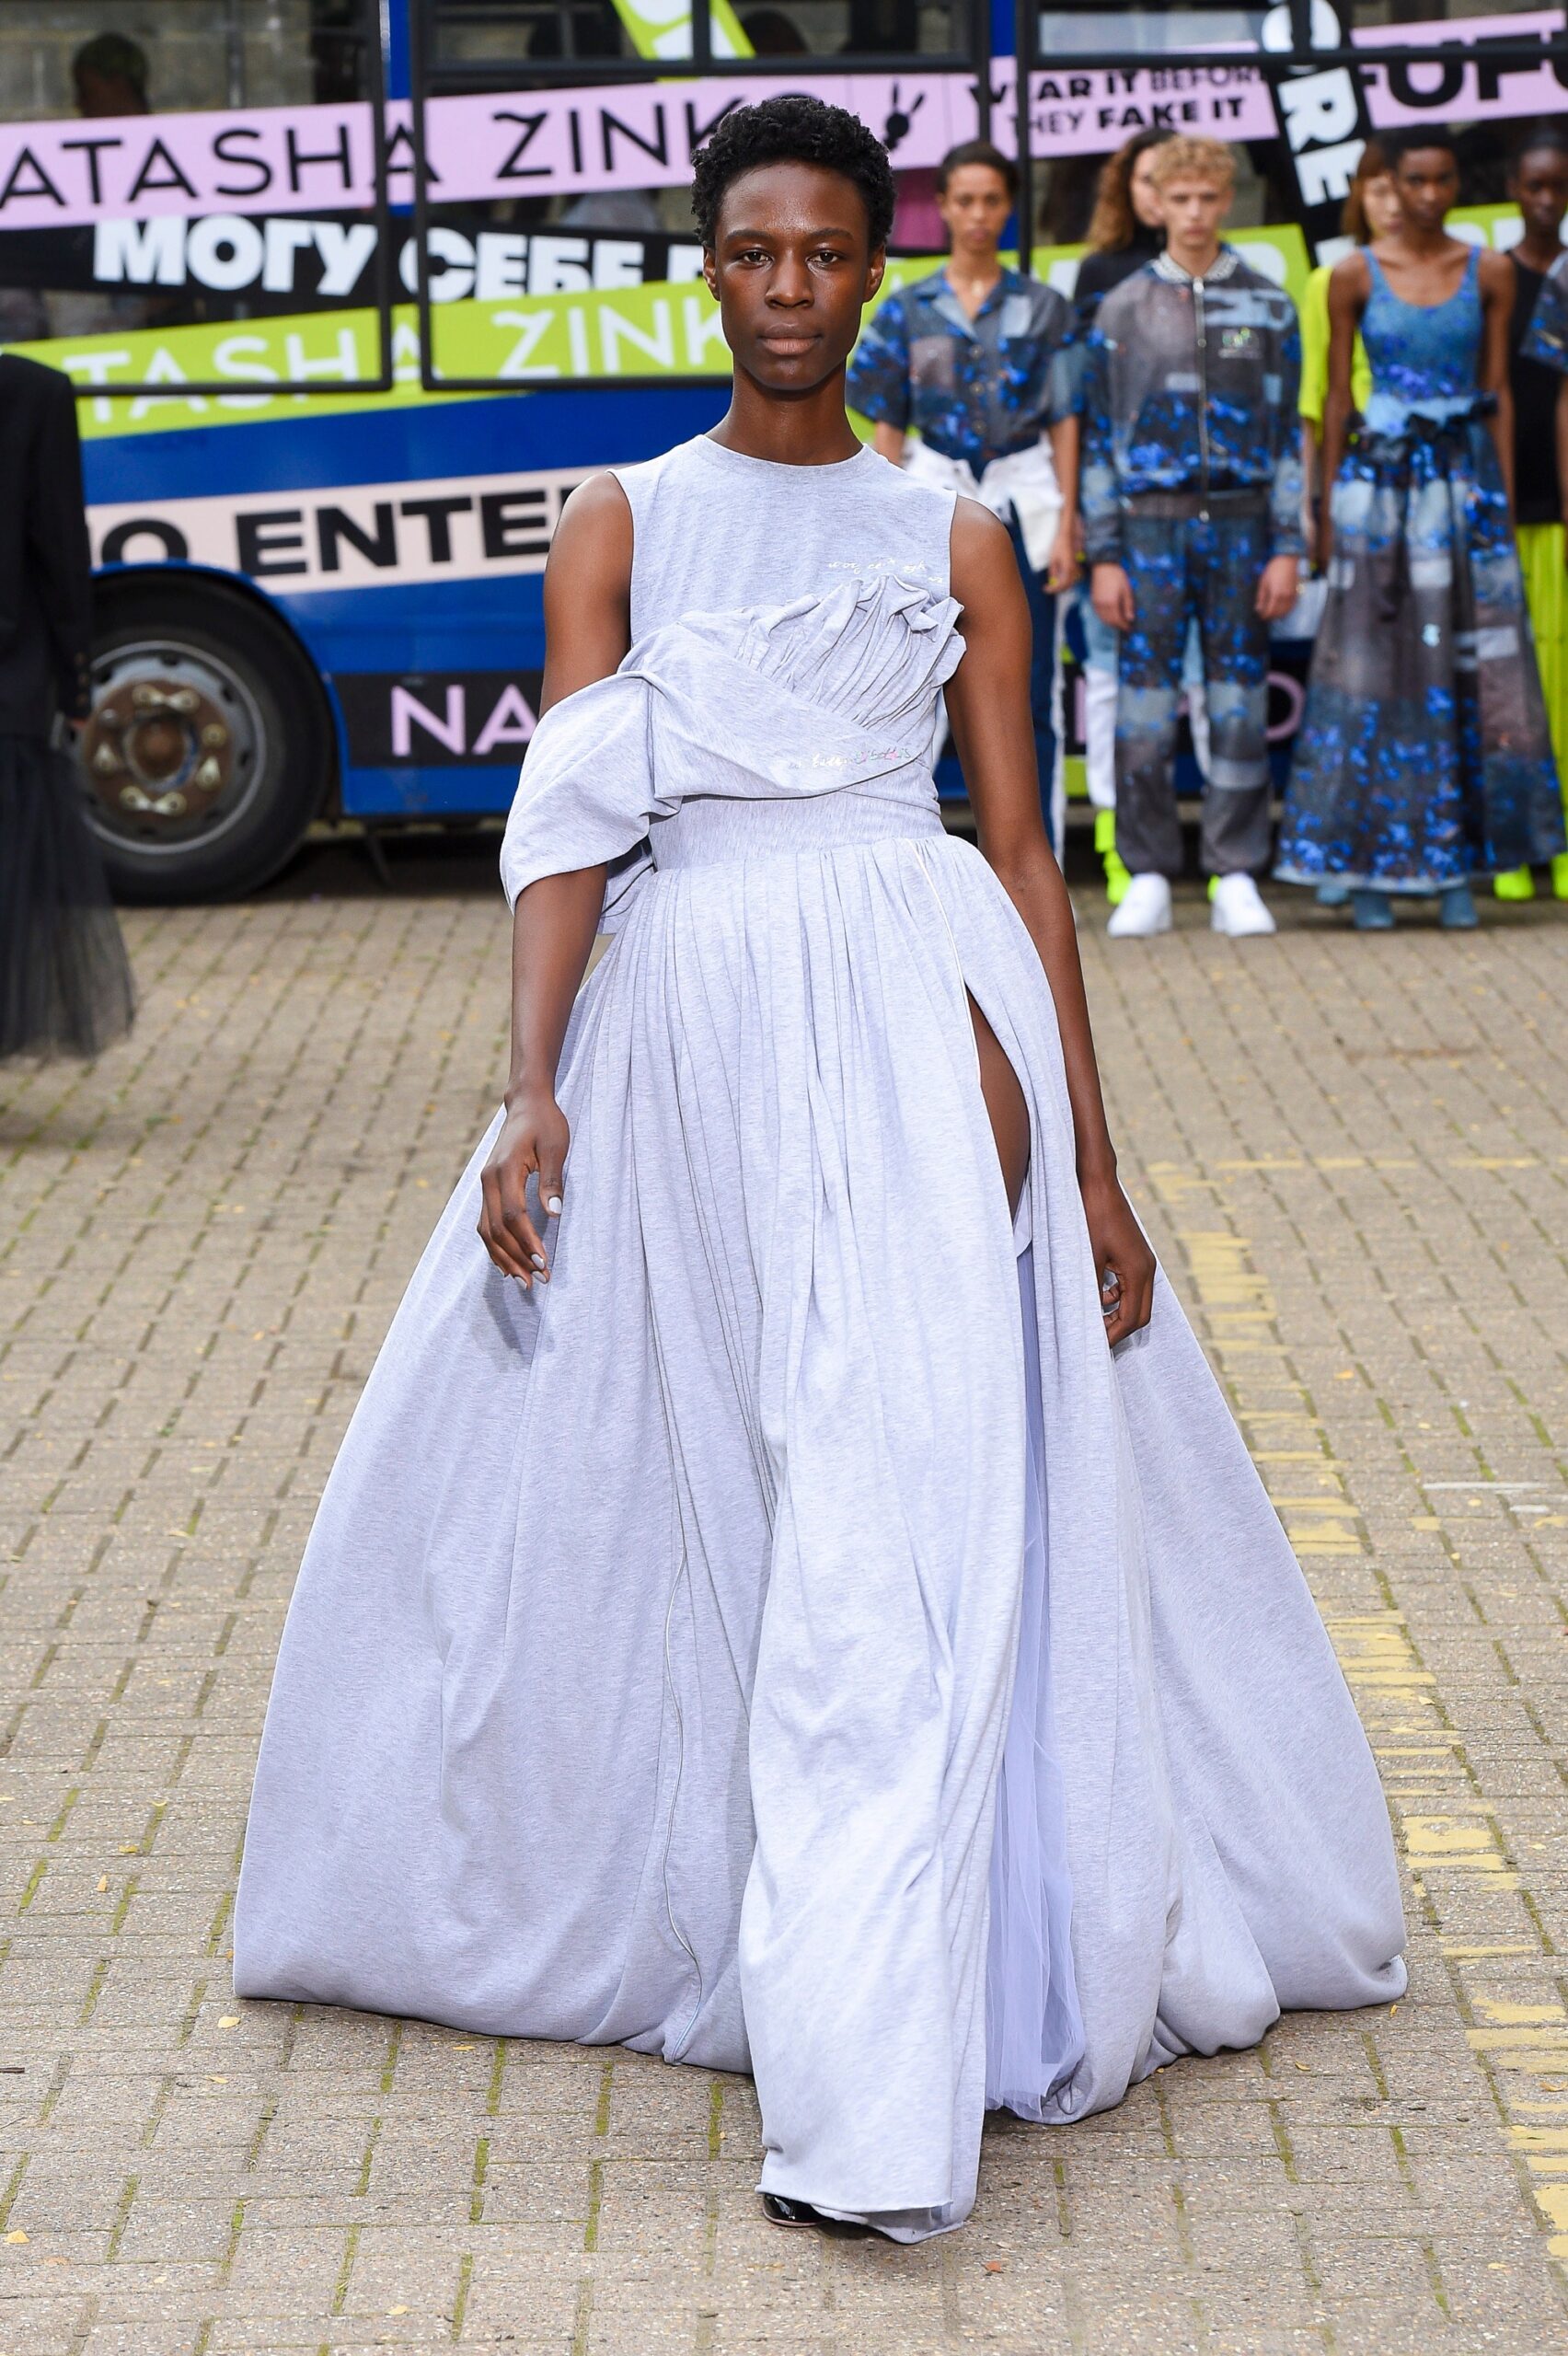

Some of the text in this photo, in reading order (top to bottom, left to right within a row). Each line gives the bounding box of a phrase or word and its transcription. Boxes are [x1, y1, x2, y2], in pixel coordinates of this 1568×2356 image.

[1107, 70, 1137, 93] IT
[1098, 102, 1199, 130] FAKE
[1212, 97, 1247, 119] IT
[93, 214, 378, 295] МОГУ
[235, 487, 572, 577] ENTE
